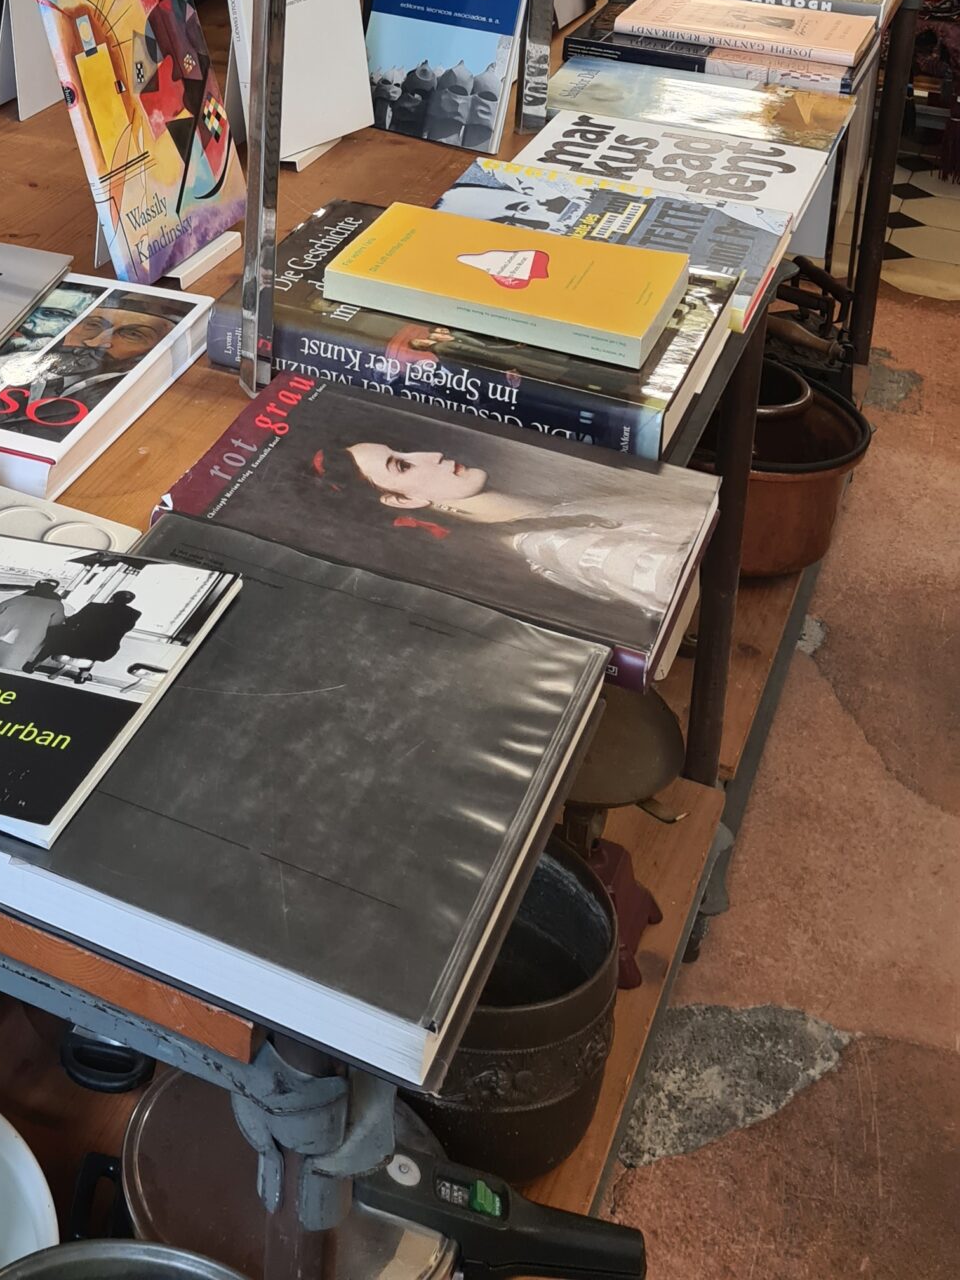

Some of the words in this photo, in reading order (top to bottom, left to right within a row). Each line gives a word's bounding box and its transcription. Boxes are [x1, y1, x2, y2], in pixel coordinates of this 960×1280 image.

[631, 25, 701, 42] REMBRANDT
[708, 36, 764, 50] GANTNER
[772, 46, 814, 59] JOSEPH
[537, 114, 617, 170] mar
[575, 133, 660, 181] kus
[644, 131, 726, 194] gad
[126, 193, 167, 232] Wassily
[641, 198, 709, 250] TEXTE
[134, 215, 193, 264] Kandinsky
[287, 216, 363, 271] Geschichte
[274, 267, 303, 292] Die
[322, 304, 361, 322] im
[224, 331, 233, 355] Lyons
[300, 336, 361, 371] Kunst
[363, 352, 404, 382] der
[403, 358, 480, 402] Spiegel
[488, 382, 518, 405] im
[209, 438, 258, 481] rot
[255, 375, 316, 436] grau
